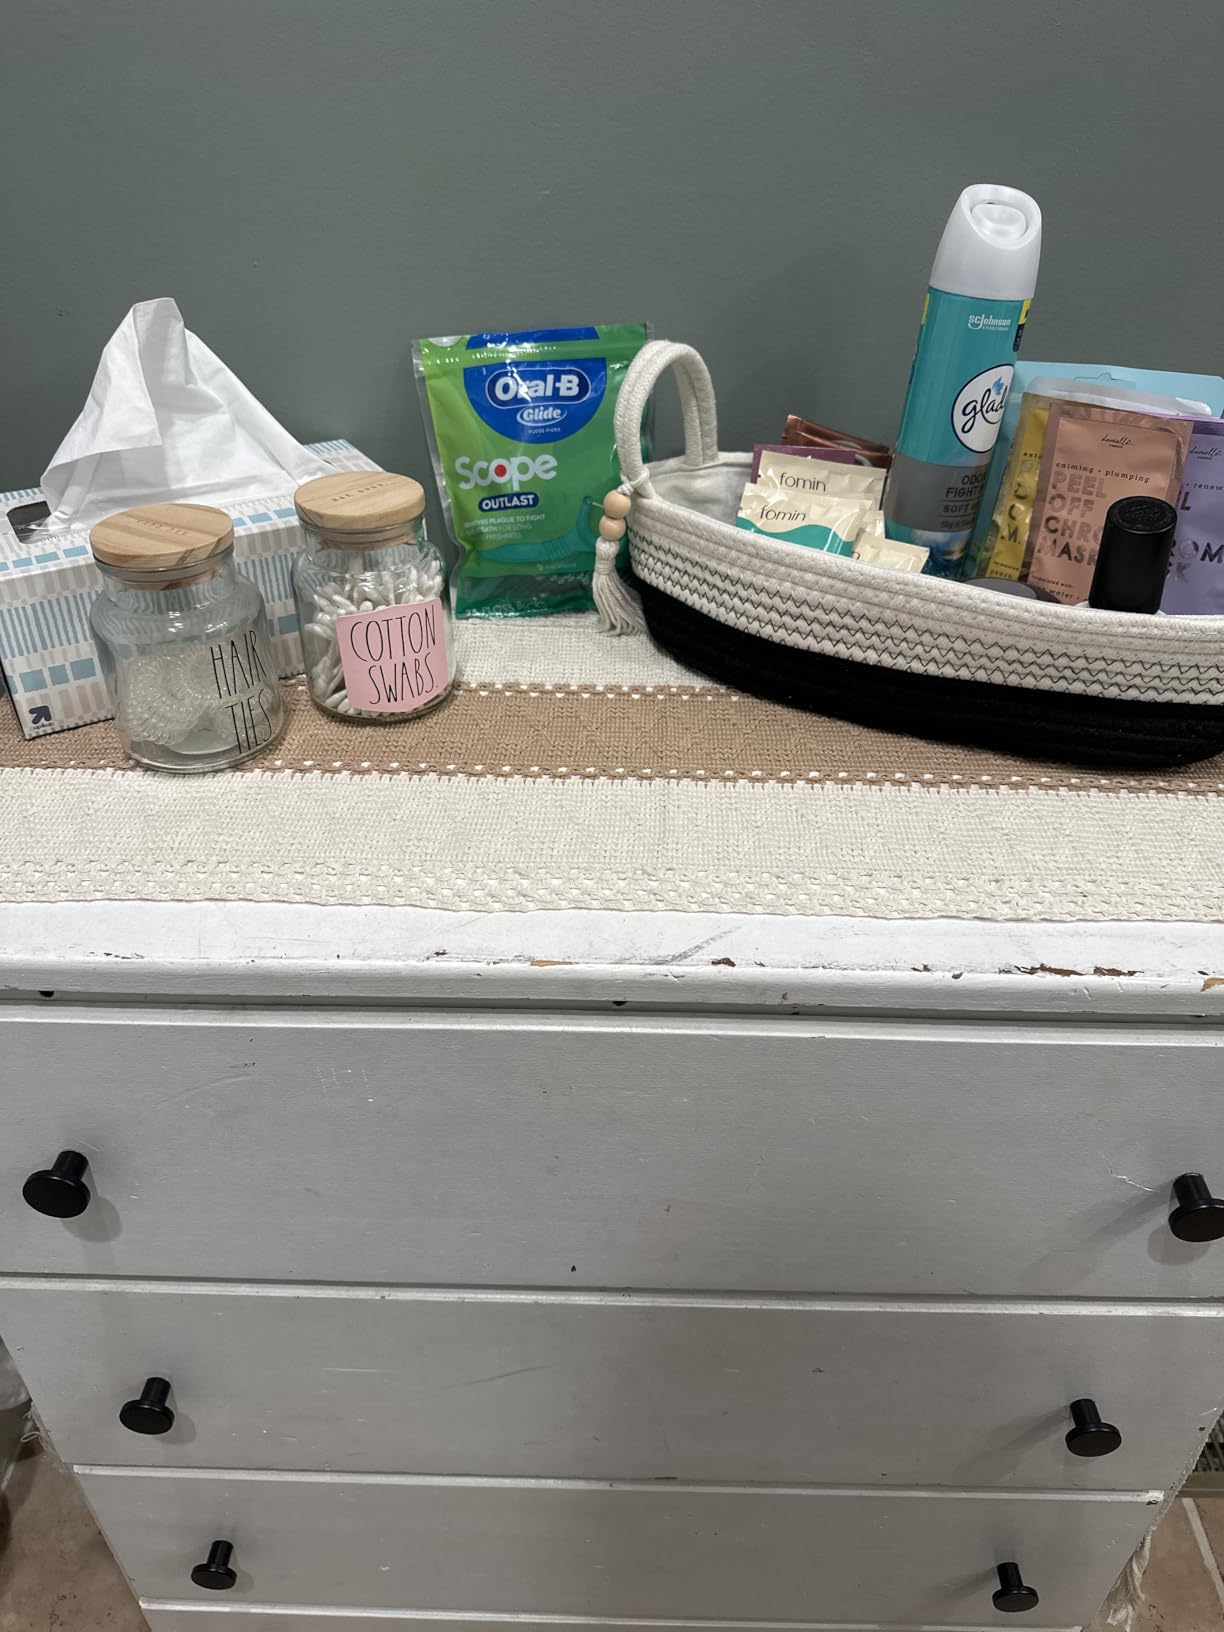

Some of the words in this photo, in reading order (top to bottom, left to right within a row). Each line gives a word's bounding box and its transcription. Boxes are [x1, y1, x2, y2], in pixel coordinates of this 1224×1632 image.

[495, 374, 579, 401] Oral-B
[522, 406, 562, 422] Glide
[961, 385, 1008, 434] glad
[455, 454, 558, 491] Scope
[779, 472, 827, 492] fomin
[1053, 470, 1107, 498] PEEL
[1055, 462, 1094, 474] calming
[1105, 469, 1151, 484] plumping
[482, 495, 535, 510] OUTLAST
[760, 505, 806, 521] fomin
[943, 503, 969, 513] SOFT
[350, 604, 436, 662] COTTON
[210, 630, 267, 699] HAIR
[225, 688, 272, 754] TIES
